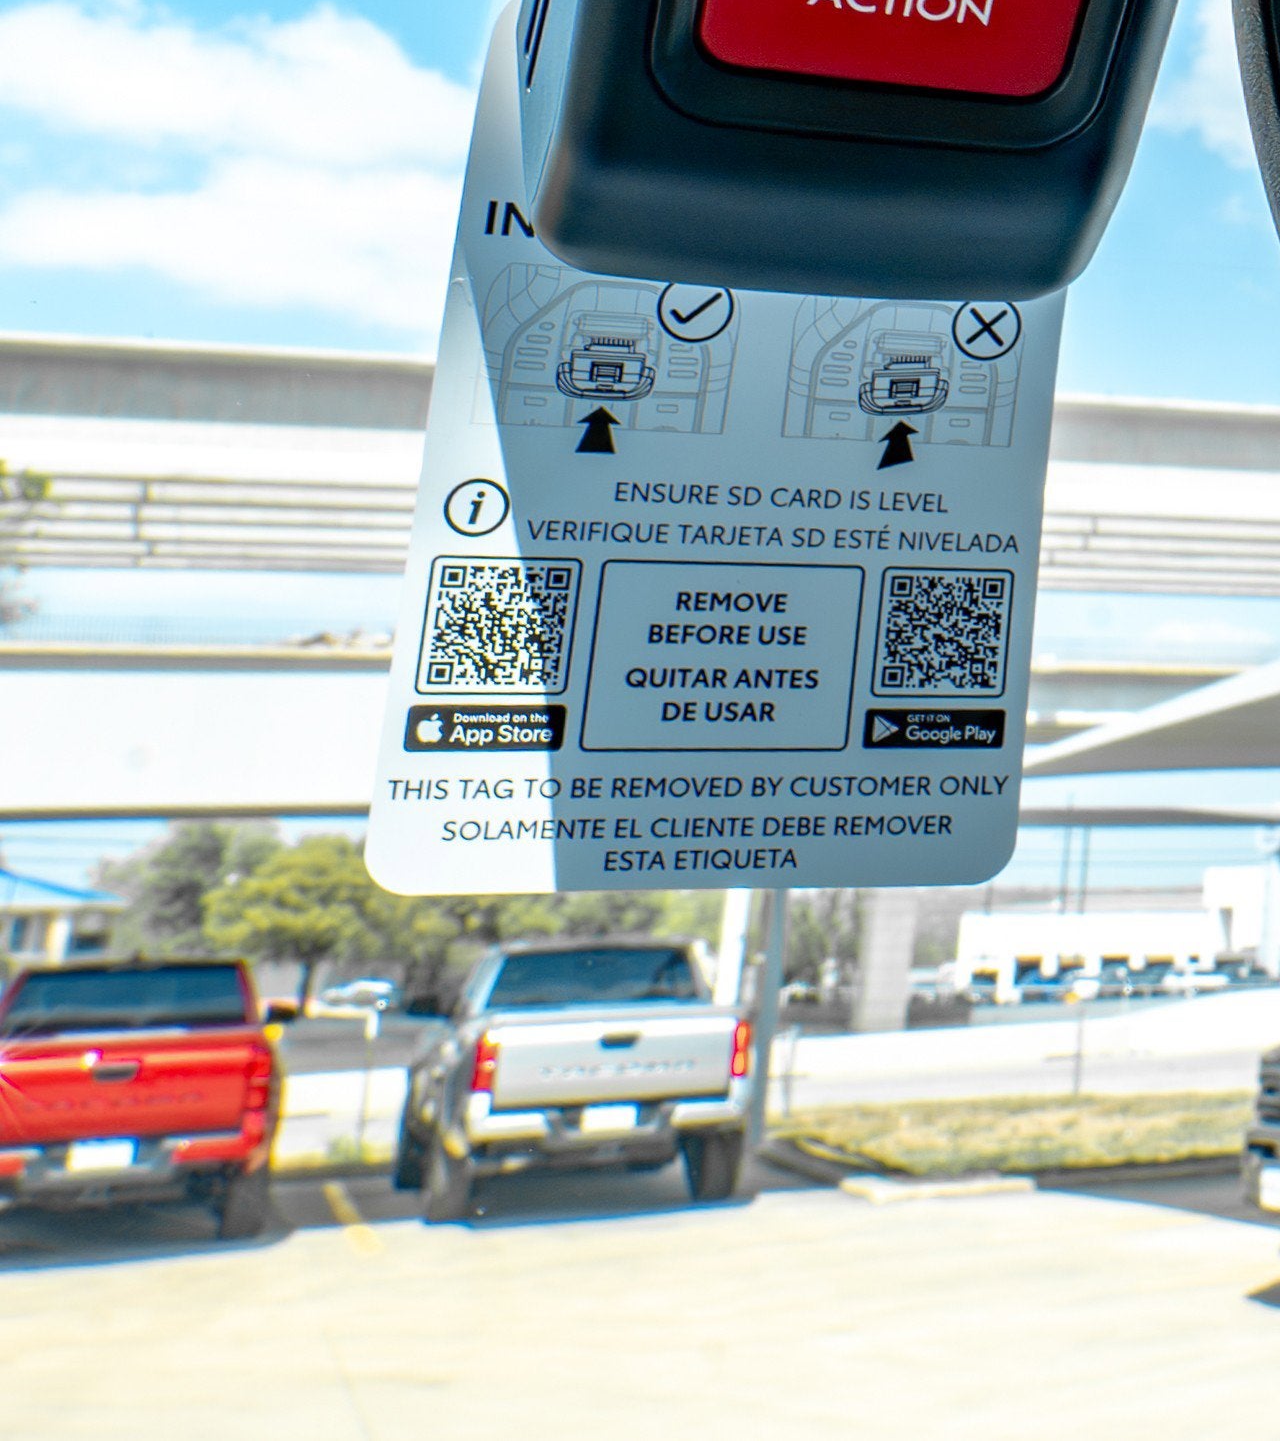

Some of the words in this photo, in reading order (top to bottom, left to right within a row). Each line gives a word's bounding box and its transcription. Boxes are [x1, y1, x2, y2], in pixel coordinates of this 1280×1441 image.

[614, 481, 720, 506] ENSURE
[726, 485, 762, 507] SD
[770, 487, 842, 510] CARD
[849, 490, 871, 511] IS
[878, 491, 949, 514] LEVEL
[527, 519, 670, 544] VERIFIQUE
[677, 523, 784, 547] TARJETA
[791, 527, 826, 548] SD
[833, 524, 891, 550] ESTÉ
[898, 531, 1019, 554] NIVELADA
[675, 591, 789, 614] REMOVE
[647, 623, 751, 646] BEFORE
[757, 625, 808, 647] USE
[624, 667, 728, 689] QUITAR
[732, 668, 819, 690] ANTES
[453, 712, 511, 724] Download
[512, 714, 527, 724] on
[529, 712, 549, 724] the
[660, 701, 698, 723] DE
[704, 701, 775, 723] USAR
[906, 713, 925, 723] GET
[926, 714, 935, 722] IT
[935, 714, 951, 723] ON
[449, 725, 494, 746] App
[498, 724, 553, 743] Store
[905, 725, 962, 745] Google
[964, 725, 996, 744] Play
[387, 778, 450, 801] THIS
[458, 778, 518, 801] TAG
[523, 778, 562, 800] TO
[569, 777, 603, 800] BE
[610, 776, 743, 799] REMOVED
[750, 776, 784, 798] BY
[789, 775, 931, 798] CUSTOMER
[939, 775, 1009, 796] ONLY
[441, 818, 606, 842] SOLAMENTE
[613, 818, 643, 839] EL
[650, 816, 755, 839] CLIENTE
[761, 816, 827, 837] DEBE
[833, 814, 952, 836] REMOVER
[603, 850, 666, 872] ESTA
[673, 848, 798, 871] ETIQUETA
